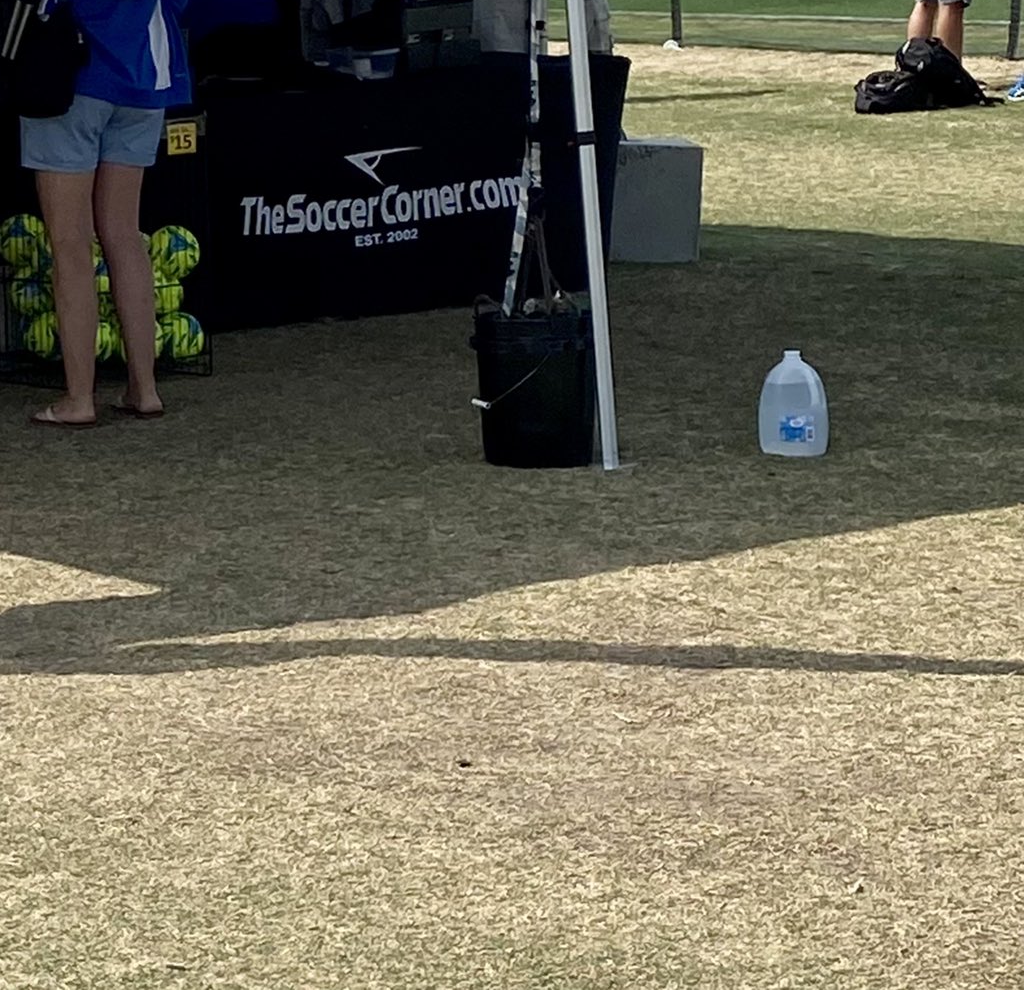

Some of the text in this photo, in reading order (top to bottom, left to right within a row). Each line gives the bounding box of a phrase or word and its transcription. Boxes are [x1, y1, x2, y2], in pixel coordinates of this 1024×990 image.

[240, 176, 523, 236] TheSoccerCorner.com
[354, 228, 418, 247] EST. 2002
